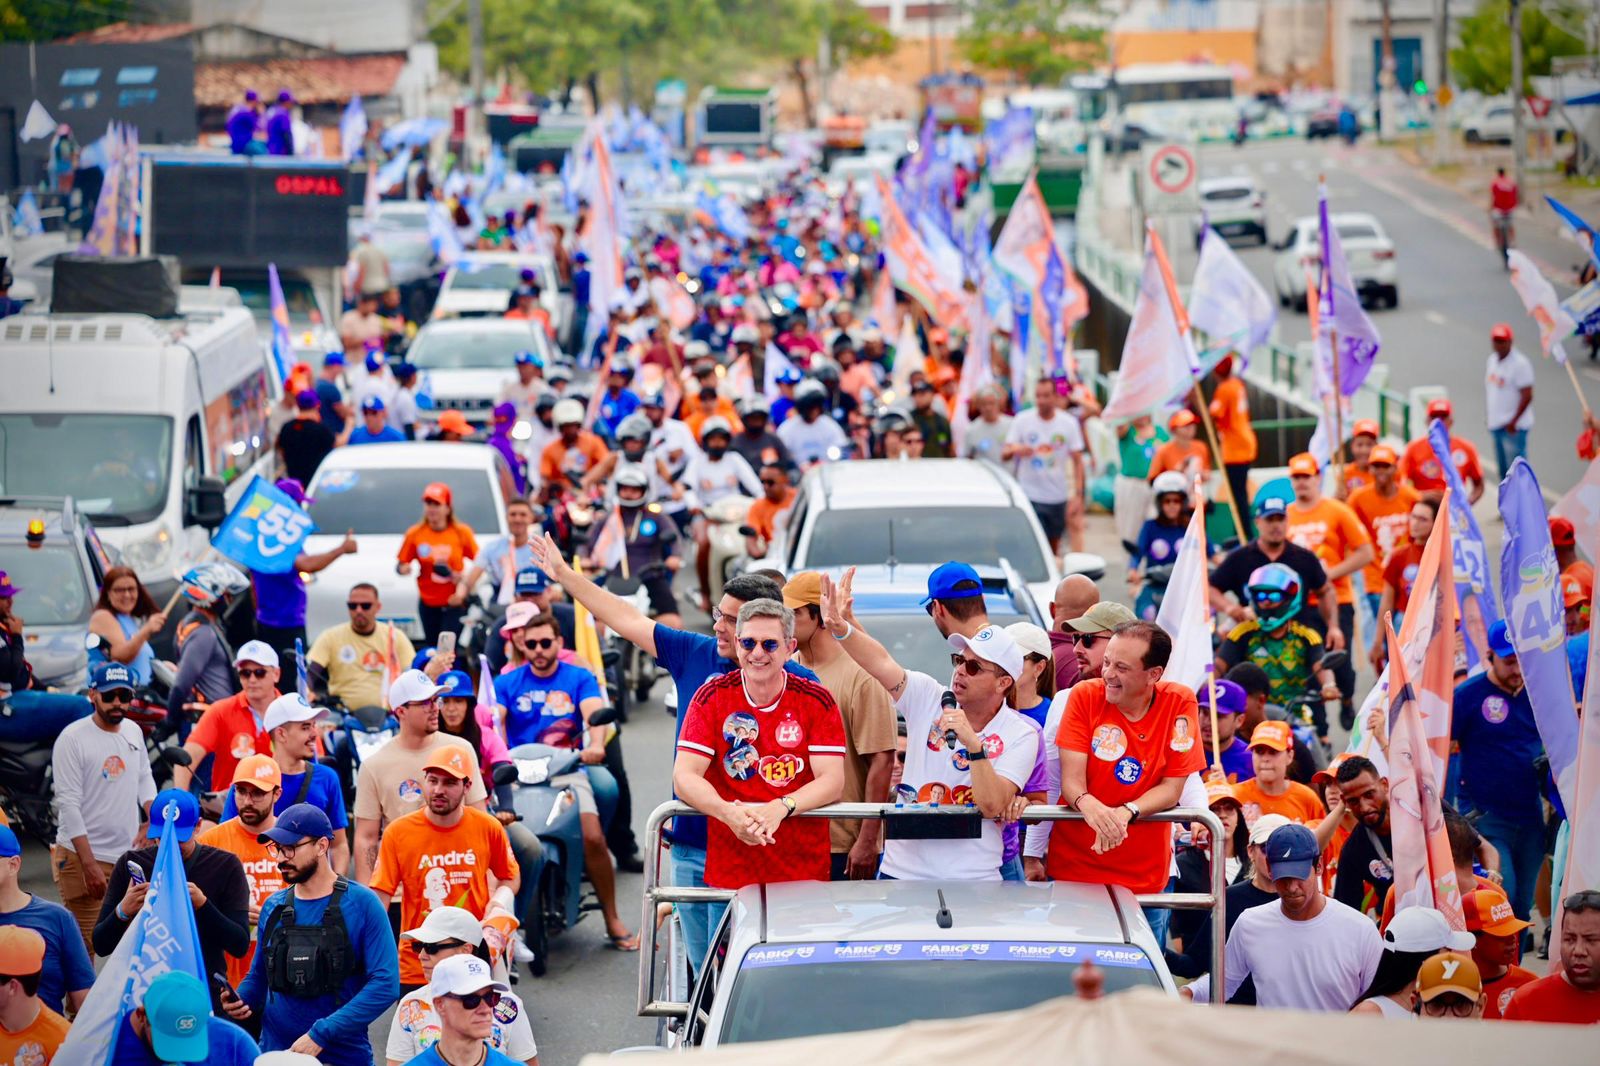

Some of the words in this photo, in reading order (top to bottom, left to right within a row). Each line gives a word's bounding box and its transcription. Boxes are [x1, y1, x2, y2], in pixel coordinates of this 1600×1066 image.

[257, 503, 313, 545] 55
[763, 760, 795, 781] 131
[418, 849, 476, 869] André
[468, 963, 482, 973] 55
